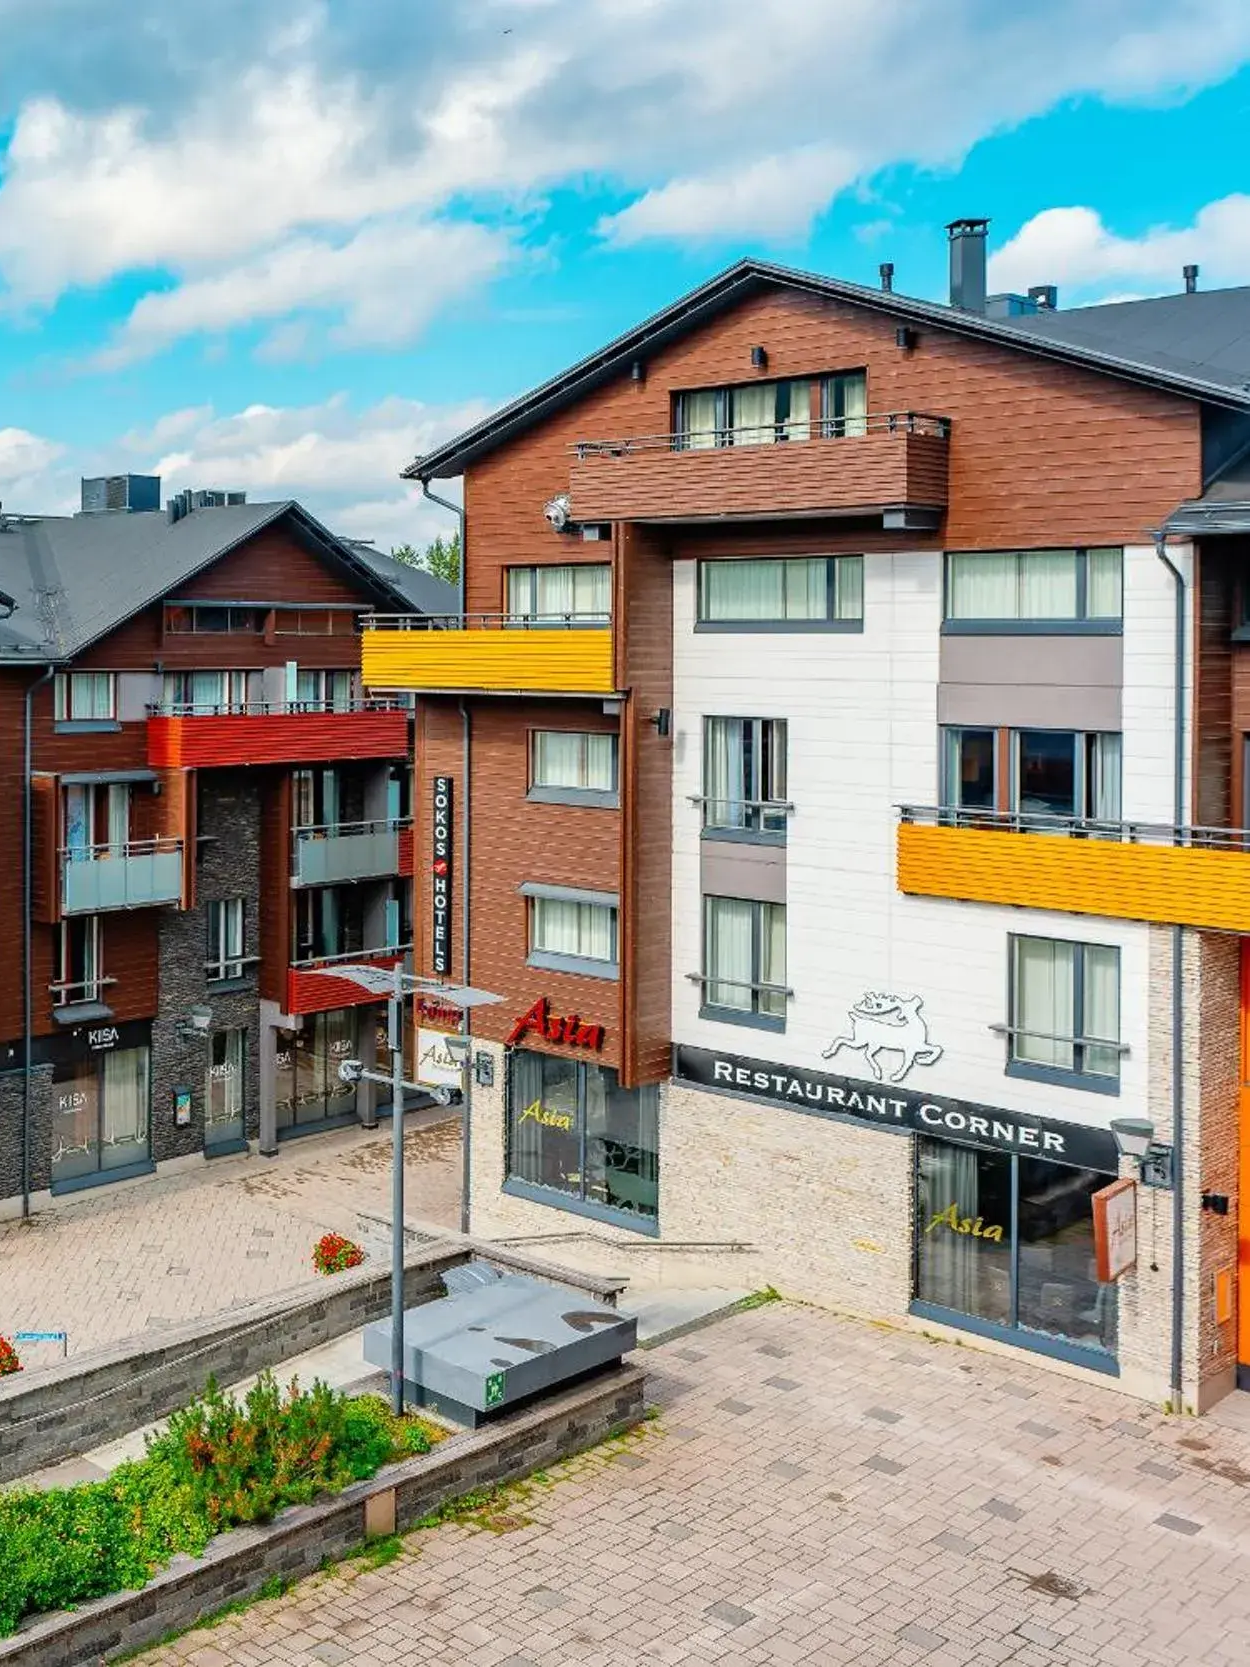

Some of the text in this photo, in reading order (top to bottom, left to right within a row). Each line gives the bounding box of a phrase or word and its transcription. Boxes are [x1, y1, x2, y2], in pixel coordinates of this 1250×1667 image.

[434, 778, 447, 856] SOKOS
[434, 878, 447, 972] HOTELS
[505, 997, 605, 1051] Asia
[517, 1098, 572, 1132] Asia
[712, 1060, 1066, 1153] RESTAURANT CORNER
[925, 1200, 1004, 1242] Asia
